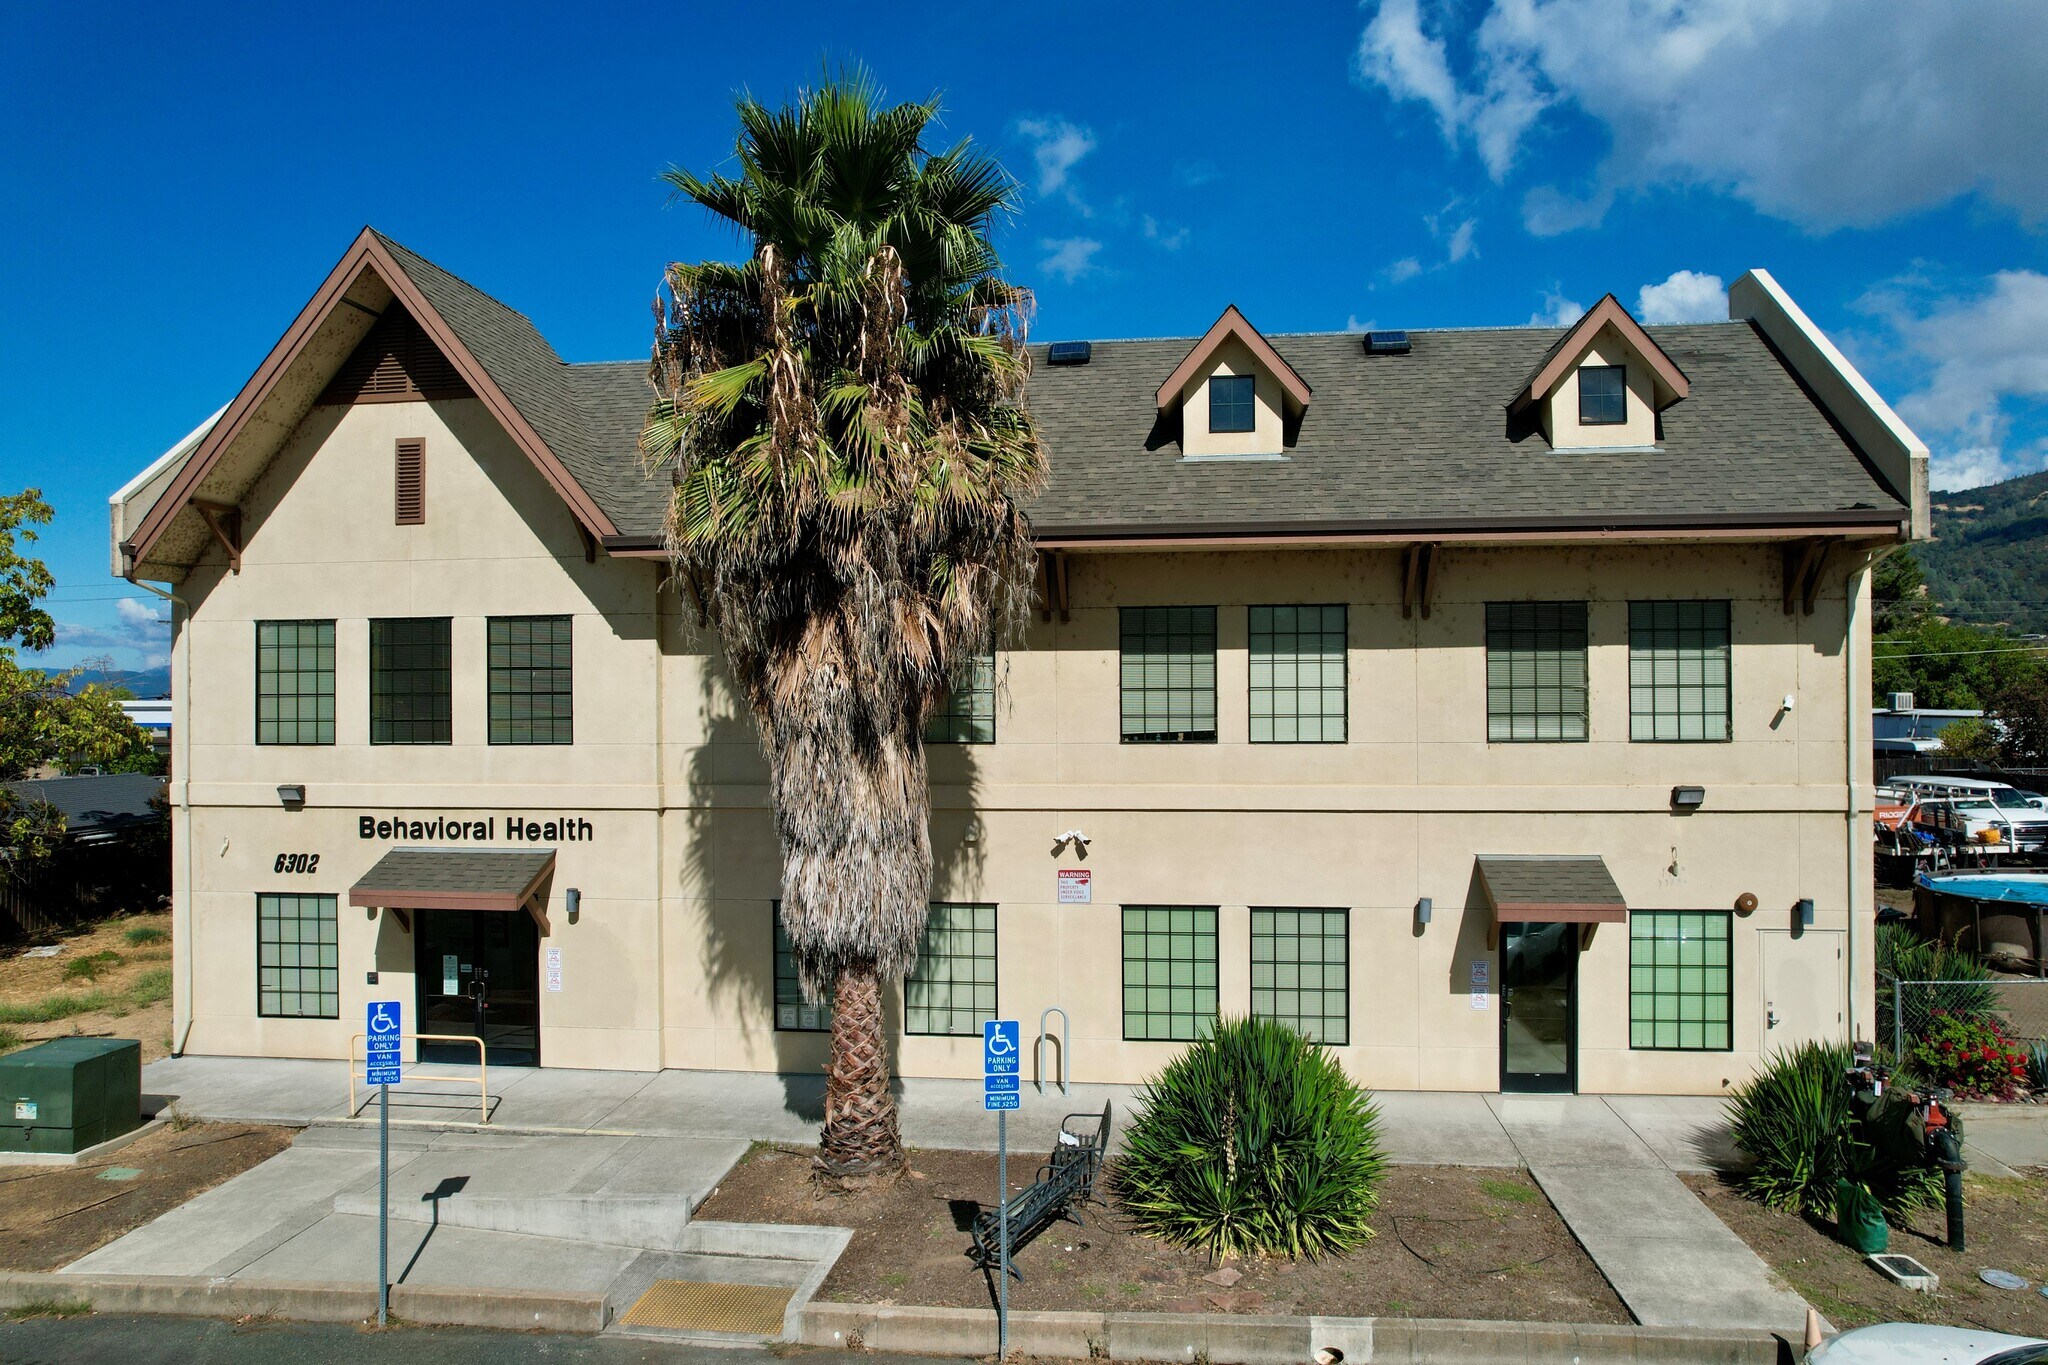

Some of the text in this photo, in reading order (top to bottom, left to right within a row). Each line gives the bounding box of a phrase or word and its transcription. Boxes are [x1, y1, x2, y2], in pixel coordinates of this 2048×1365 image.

[359, 816, 593, 842] Behavioral Health
[274, 853, 320, 874] 6302
[367, 1034, 400, 1042] PARKING
[374, 1042, 394, 1050] ONLY
[987, 1056, 1016, 1065] PARKING
[993, 1064, 1011, 1072] ONLY
